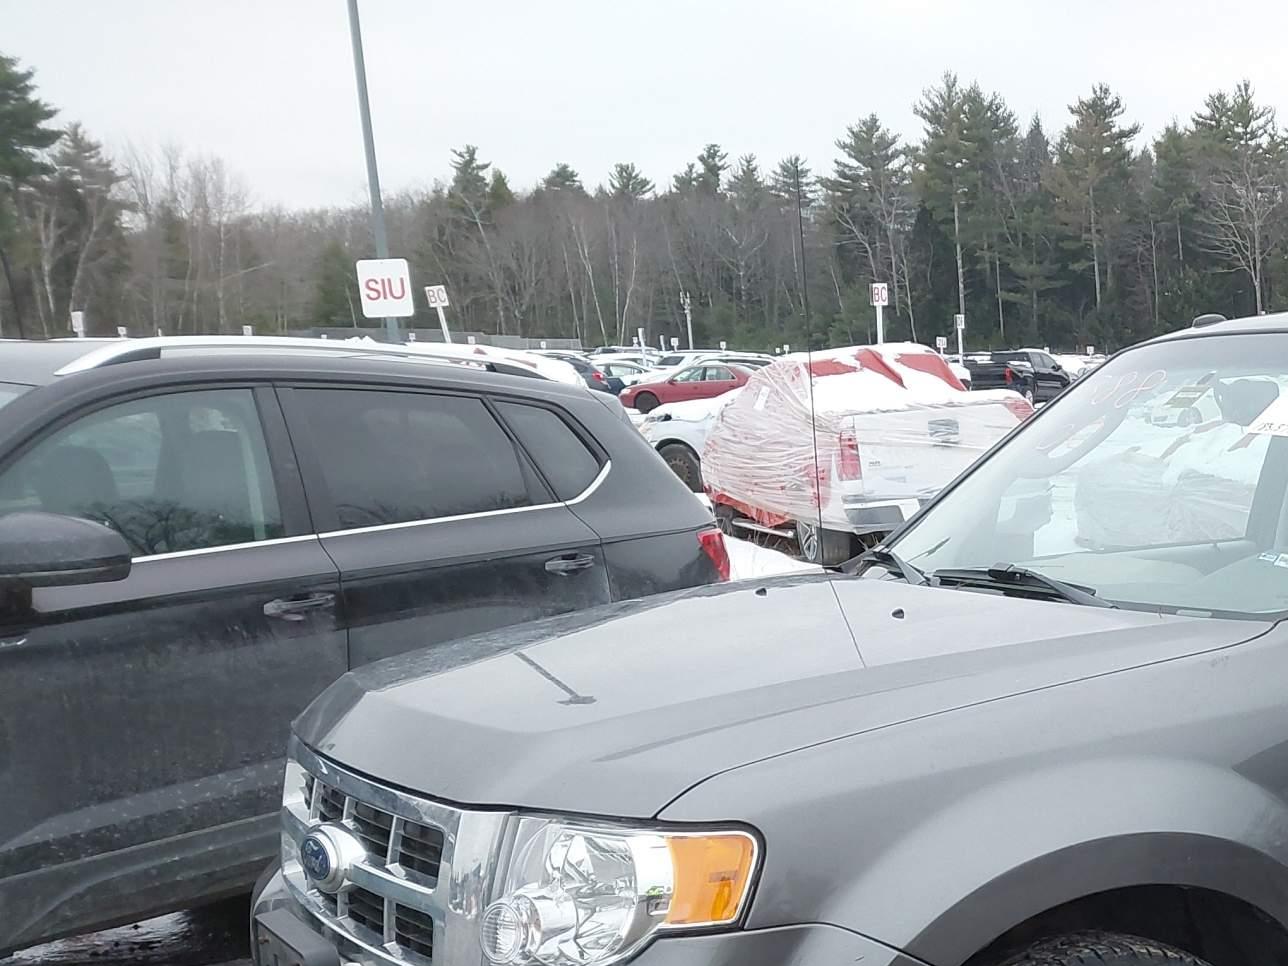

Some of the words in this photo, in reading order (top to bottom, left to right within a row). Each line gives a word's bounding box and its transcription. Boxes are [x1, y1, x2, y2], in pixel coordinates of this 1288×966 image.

[365, 278, 406, 301] SIU
[427, 288, 447, 304] BC
[873, 286, 888, 303] BC
